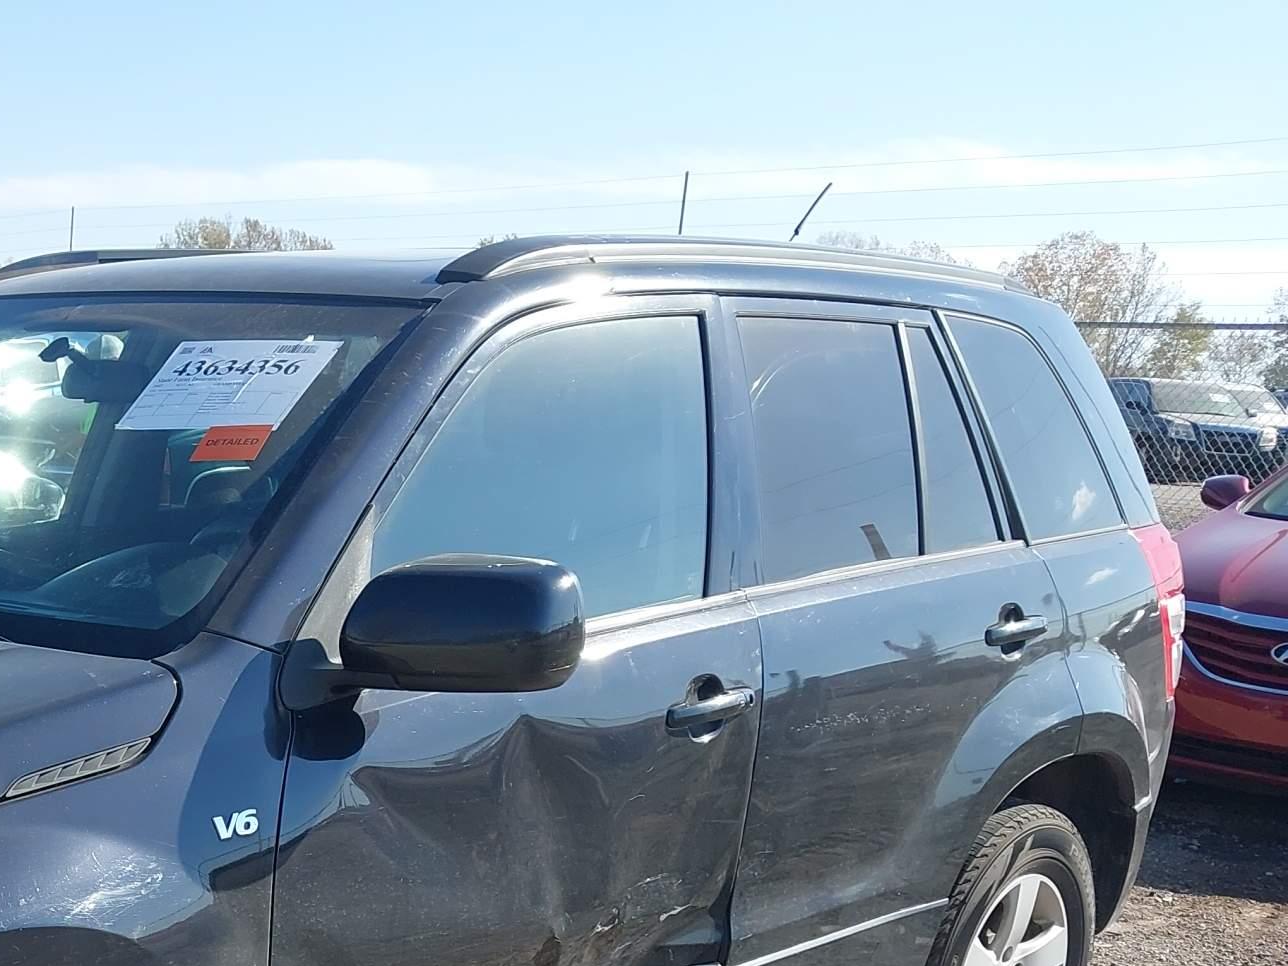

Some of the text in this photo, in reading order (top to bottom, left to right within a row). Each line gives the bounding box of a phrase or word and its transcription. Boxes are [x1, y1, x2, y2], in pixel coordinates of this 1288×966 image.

[173, 359, 305, 376] 43634356
[206, 438, 259, 447] DETAILED
[212, 808, 259, 840] V6
